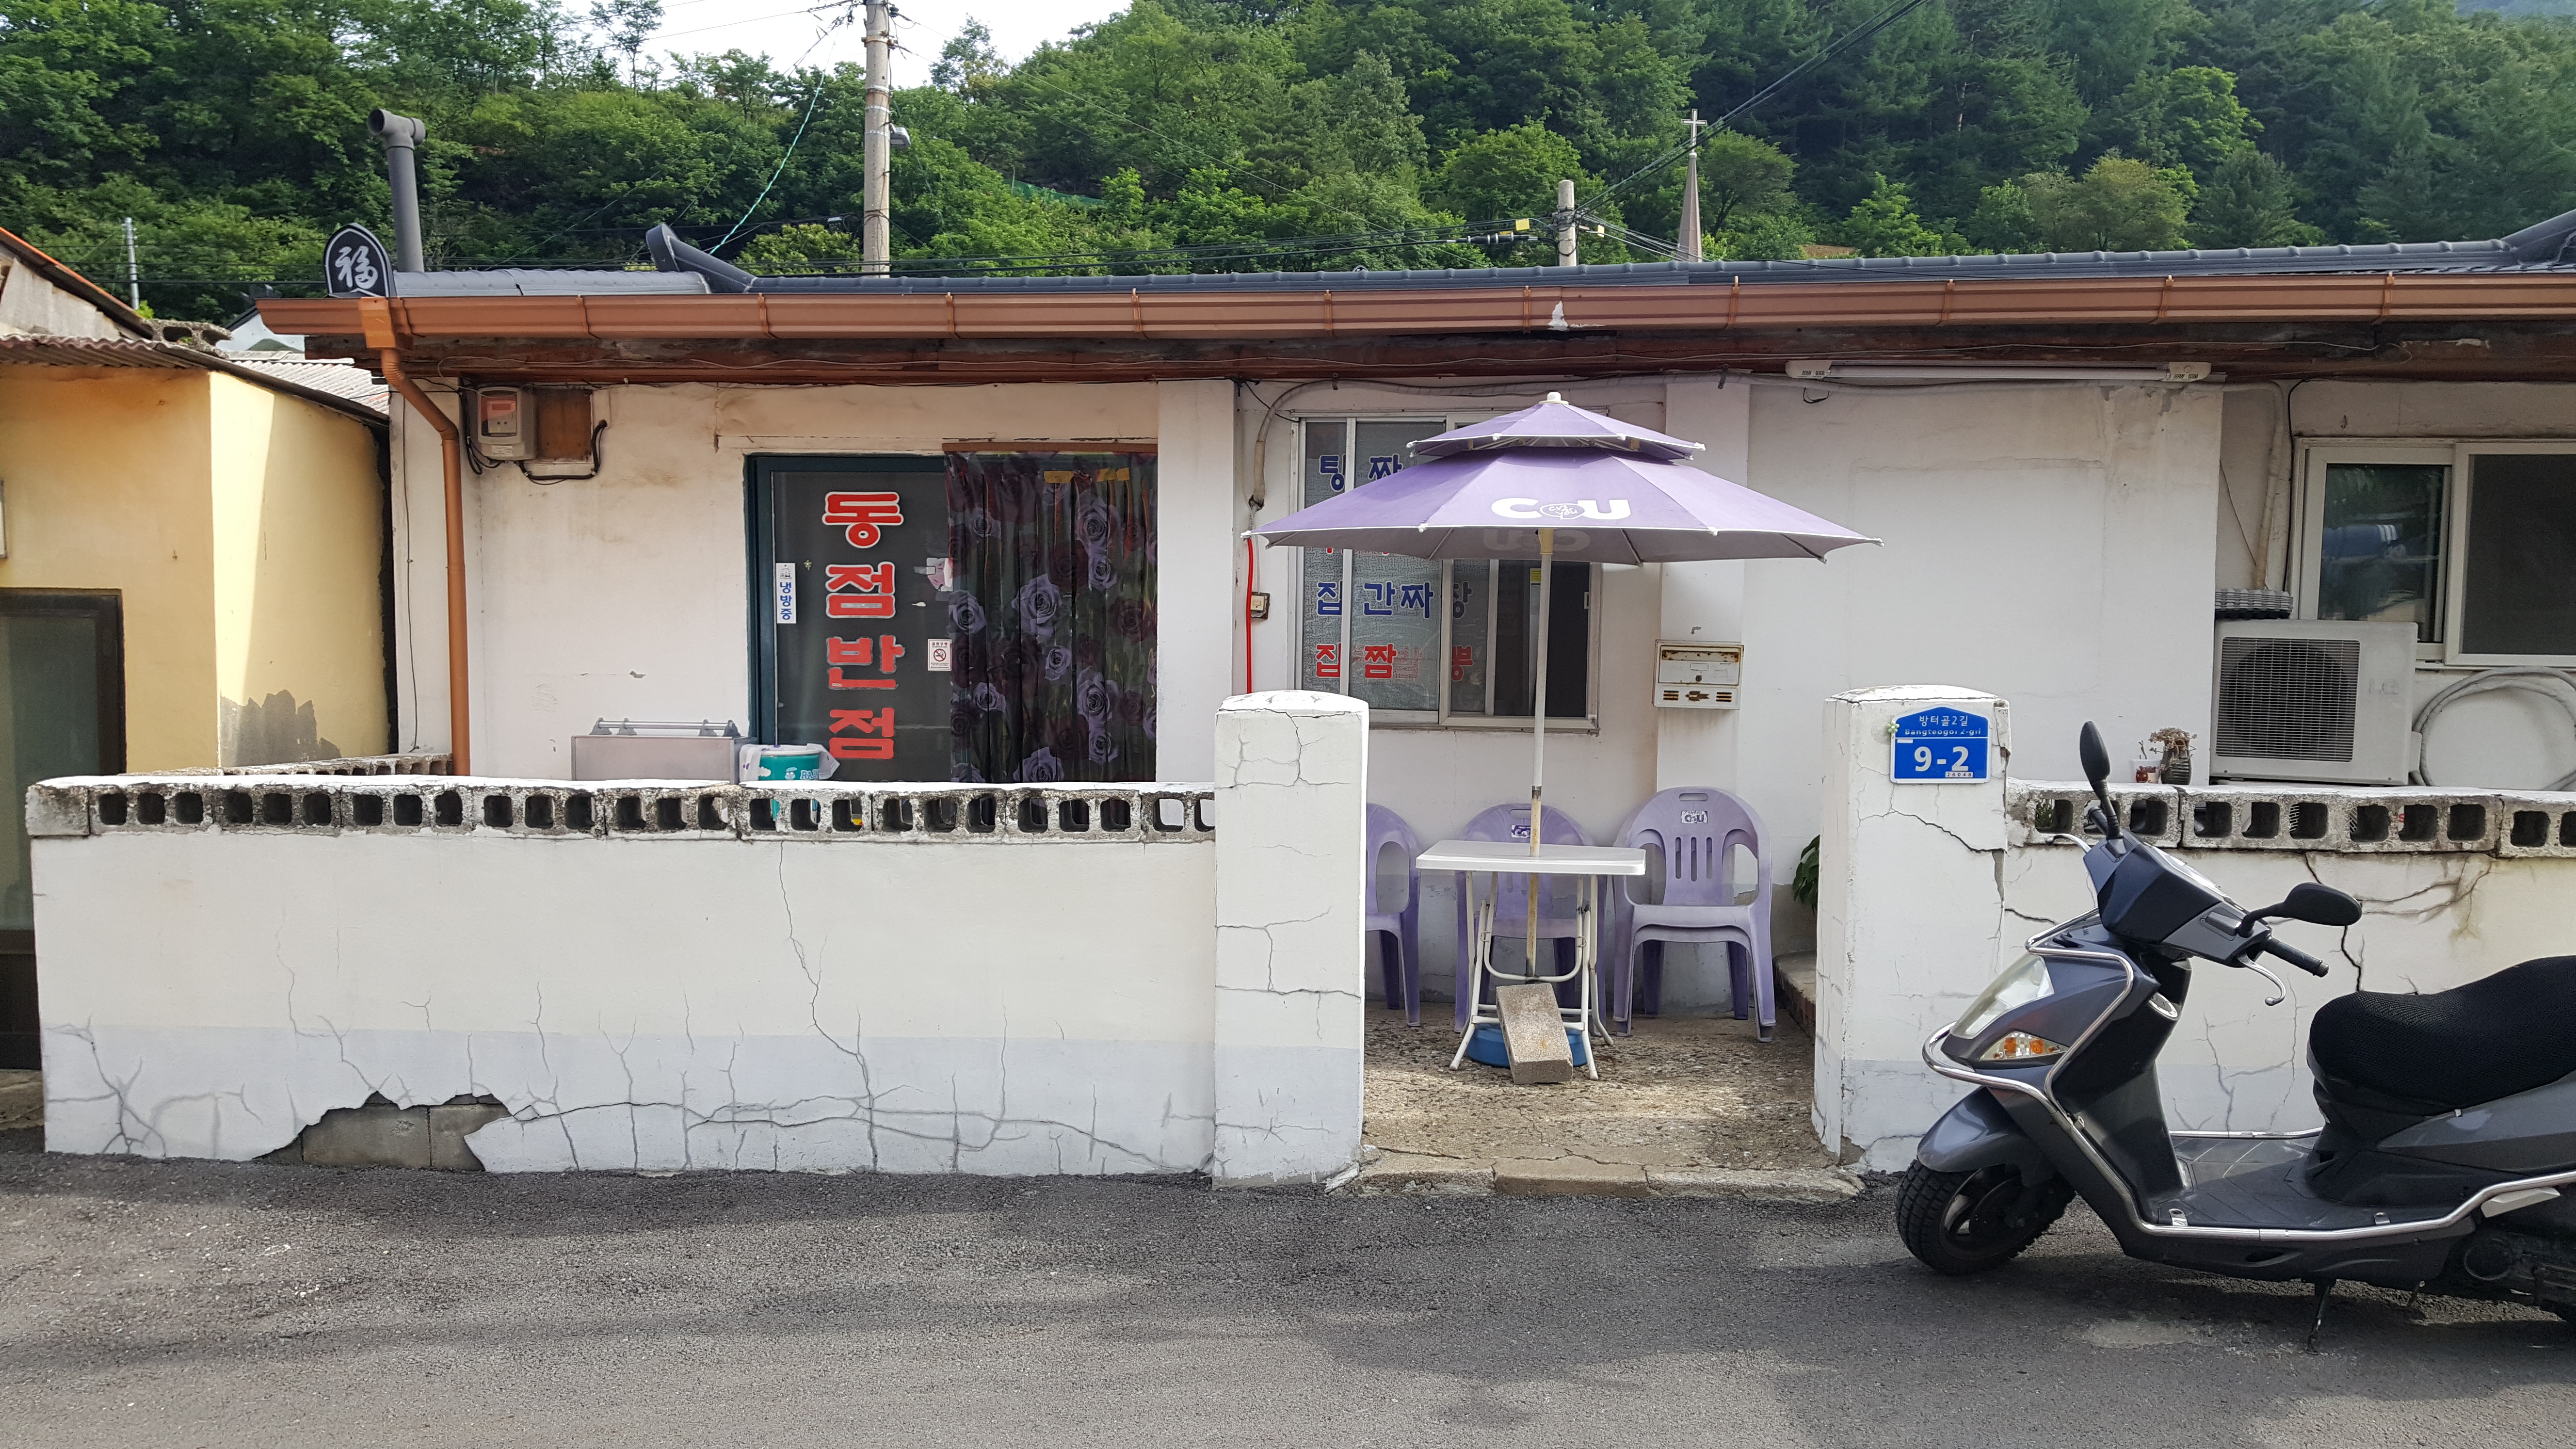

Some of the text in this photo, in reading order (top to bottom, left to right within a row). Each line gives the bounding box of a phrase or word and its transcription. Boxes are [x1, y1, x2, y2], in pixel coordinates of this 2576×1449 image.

[335, 245, 378, 289] 福
[779, 581, 793, 620] 냉방중
[822, 492, 905, 759] 동점반점
[1919, 715, 1968, 727] 방터골2길
[1914, 746, 1969, 772] 9-2
